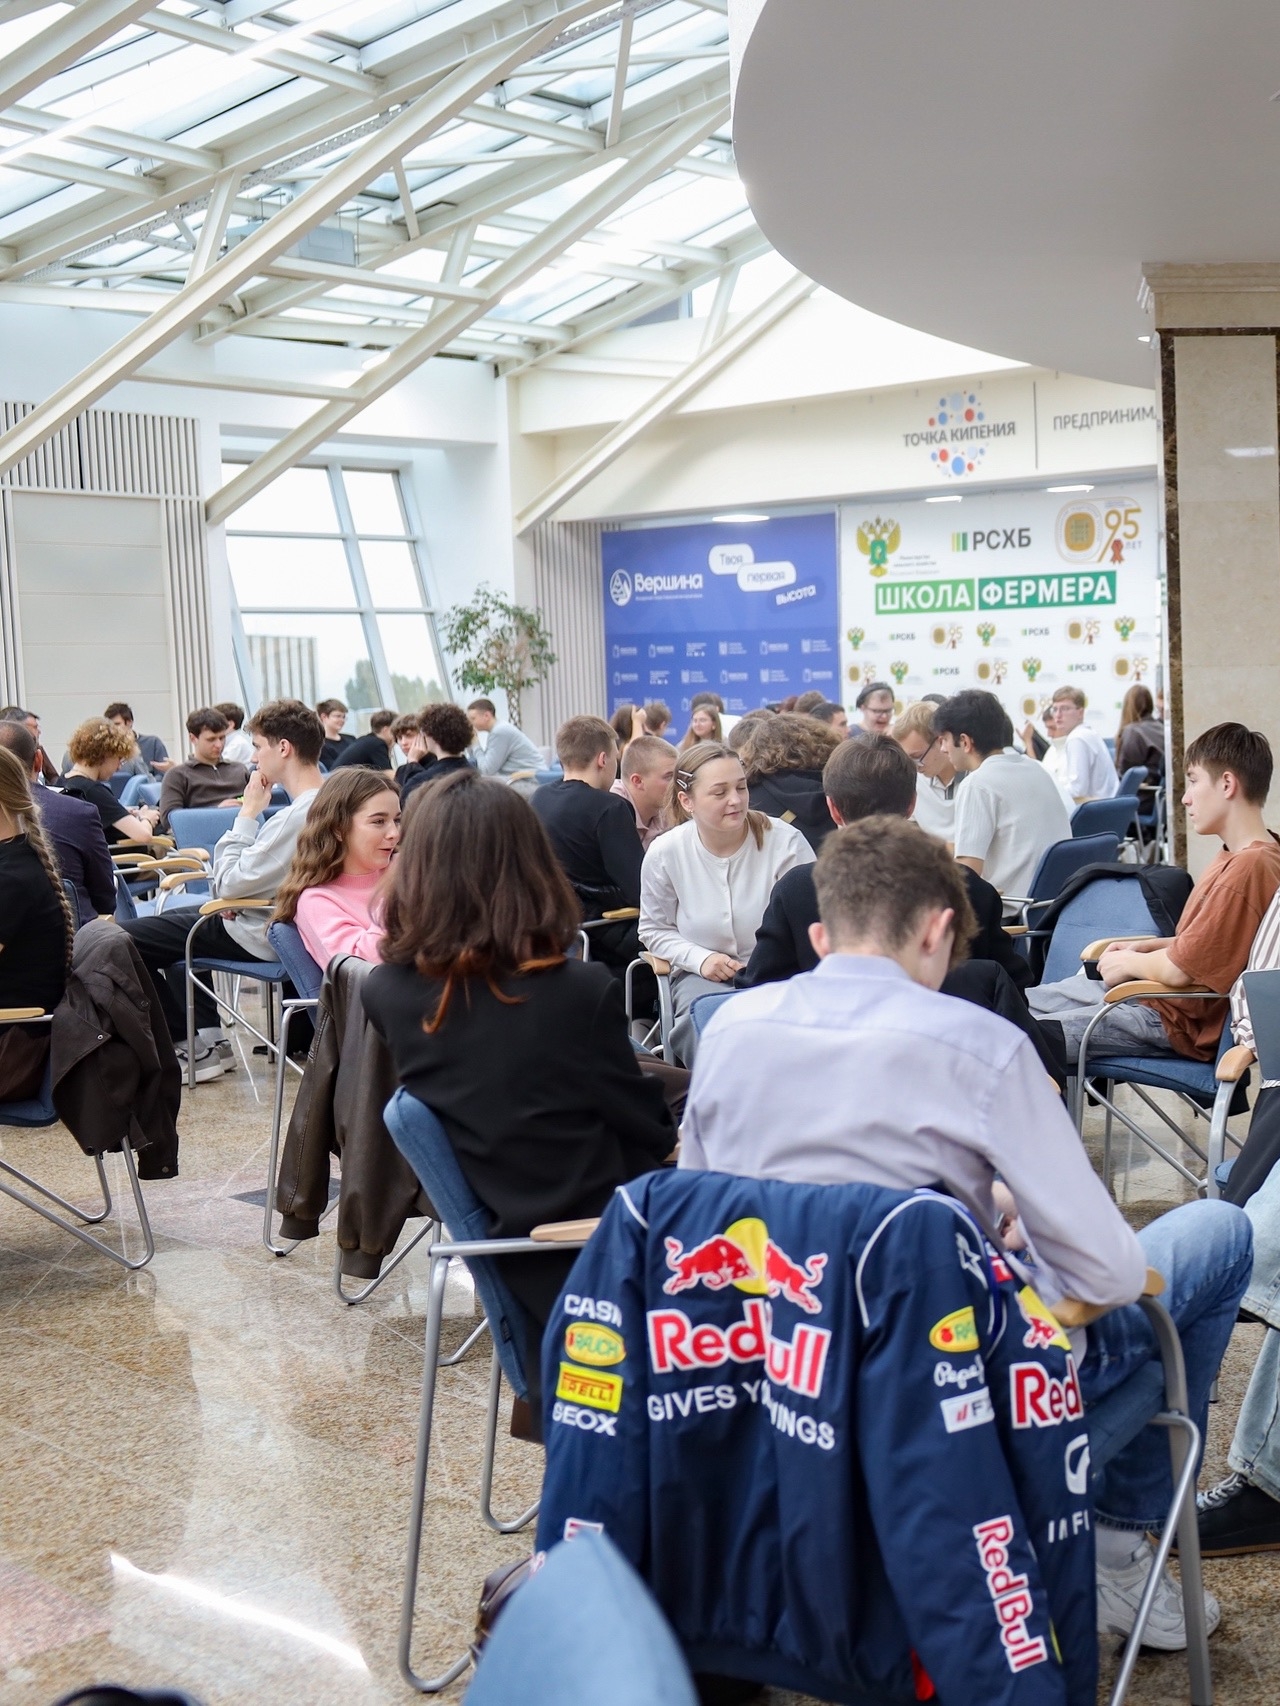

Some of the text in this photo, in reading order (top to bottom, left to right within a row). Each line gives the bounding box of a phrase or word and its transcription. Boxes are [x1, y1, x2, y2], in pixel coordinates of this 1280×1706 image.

[1053, 406, 1157, 431] ПРЕДПРИНИМ
[903, 421, 1016, 447] ТОЧКА КИПЕНИЯ
[972, 528, 1032, 552] РСХБ
[1097, 507, 1142, 563] 95
[720, 553, 743, 566] Твоя
[635, 573, 703, 595] Вершина
[747, 571, 785, 584] первая
[776, 585, 816, 606] высота
[878, 576, 1113, 611] ШКОЛА ФЕРМЕРА
[647, 1298, 832, 1399] Red ull
[647, 1385, 737, 1421] GIVES
[1009, 1353, 1084, 1430] Red
[552, 1401, 618, 1436] GEOX
[972, 1514, 1048, 1674] Red Bull
